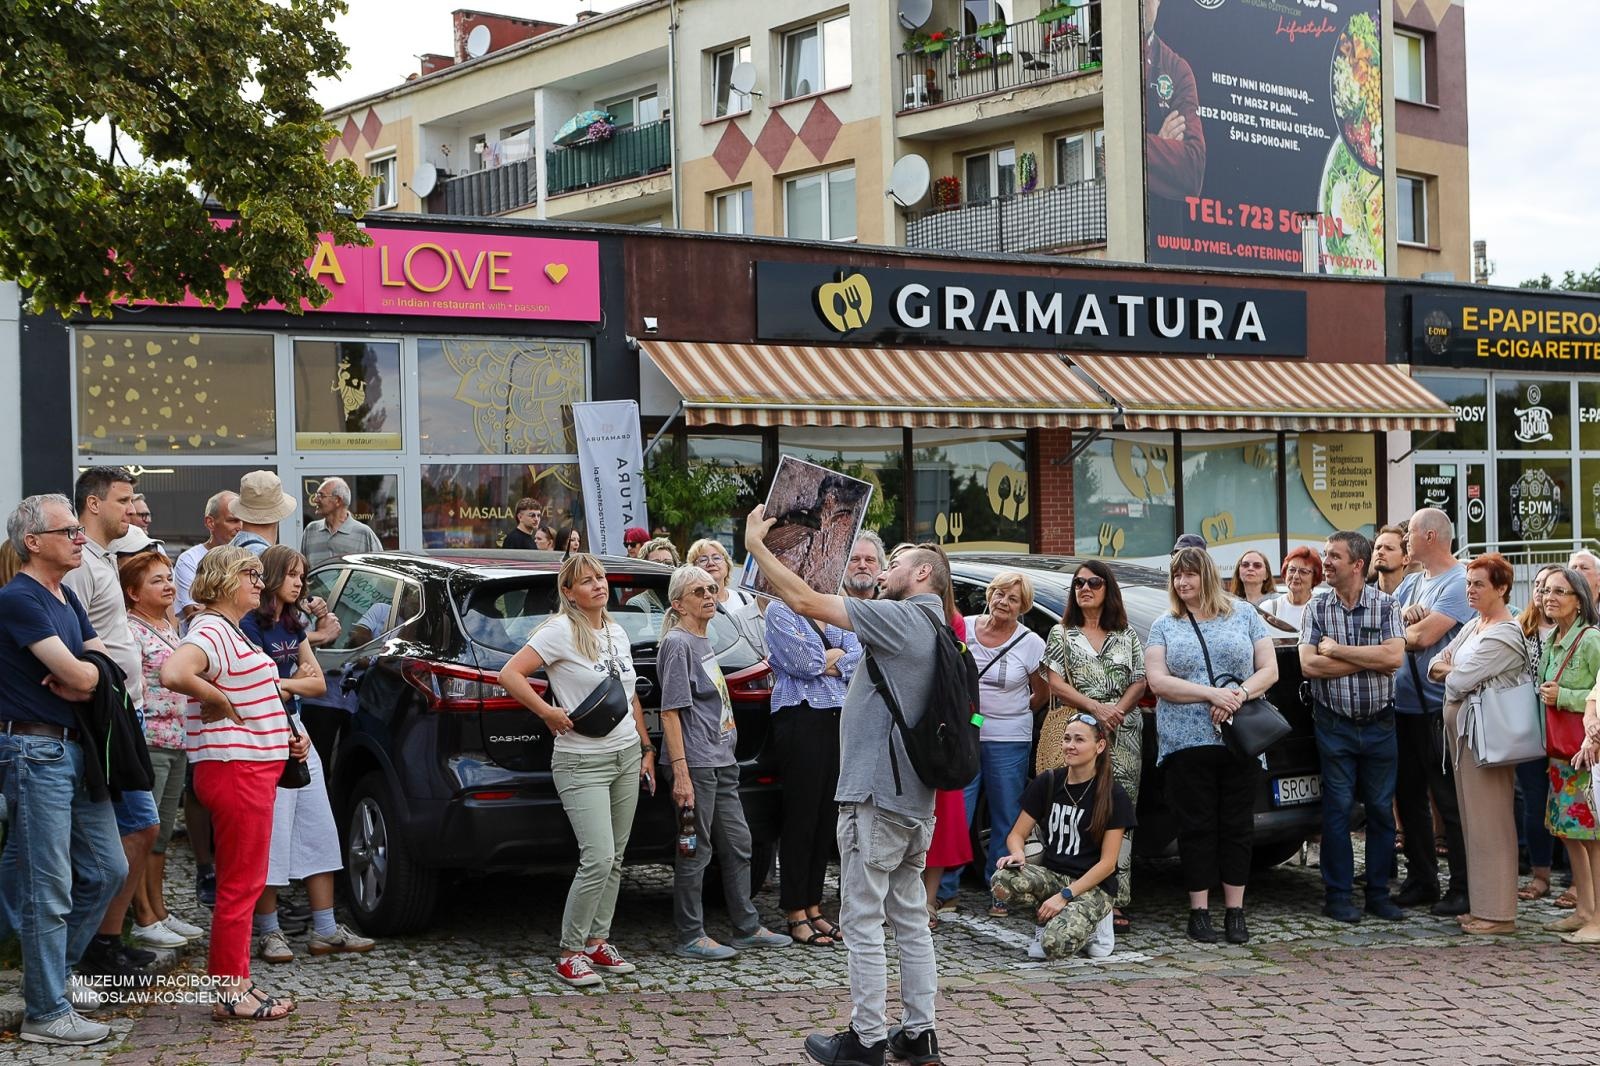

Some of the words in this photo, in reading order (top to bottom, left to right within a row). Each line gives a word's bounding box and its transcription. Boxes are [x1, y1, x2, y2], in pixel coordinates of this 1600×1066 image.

[1275, 15, 1336, 42] Lifestyle
[1212, 71, 1238, 87] KIEDY
[1240, 77, 1258, 91] INNI
[1231, 93, 1242, 105] TY
[1244, 97, 1268, 111] MASZ
[1270, 101, 1298, 116] PLAN...
[1196, 106, 1219, 119] JEDZ
[1220, 109, 1258, 128] DOBRZE,
[1260, 117, 1293, 132] TRENUJ
[1229, 126, 1249, 142] ŚPIJ
[1251, 133, 1301, 151] SPOKOJNIE.
[1185, 196, 1233, 226] TEL:
[1239, 203, 1274, 231] 723
[1279, 209, 1312, 234] 50
[381, 242, 513, 293] LOVE
[382, 298, 395, 306] an
[397, 298, 430, 308] Indian
[433, 299, 486, 311] restaurant
[488, 302, 506, 311] with
[514, 303, 551, 313] passion
[896, 283, 1267, 342] GRAMATURA
[1462, 306, 1600, 336] E-PAPIERO
[1428, 327, 1448, 336] E-DYM
[1328, 444, 1343, 453] sport
[1313, 443, 1327, 491] DIETY
[1329, 456, 1363, 465] ketogeniczna
[1420, 477, 1452, 485] E-PAPIEROSY
[1330, 490, 1364, 499] zbilansowana
[1427, 489, 1446, 497] E-DYM
[459, 507, 514, 518] MASALA
[1331, 502, 1343, 511] vege
[1519, 501, 1552, 514] E-DYM
